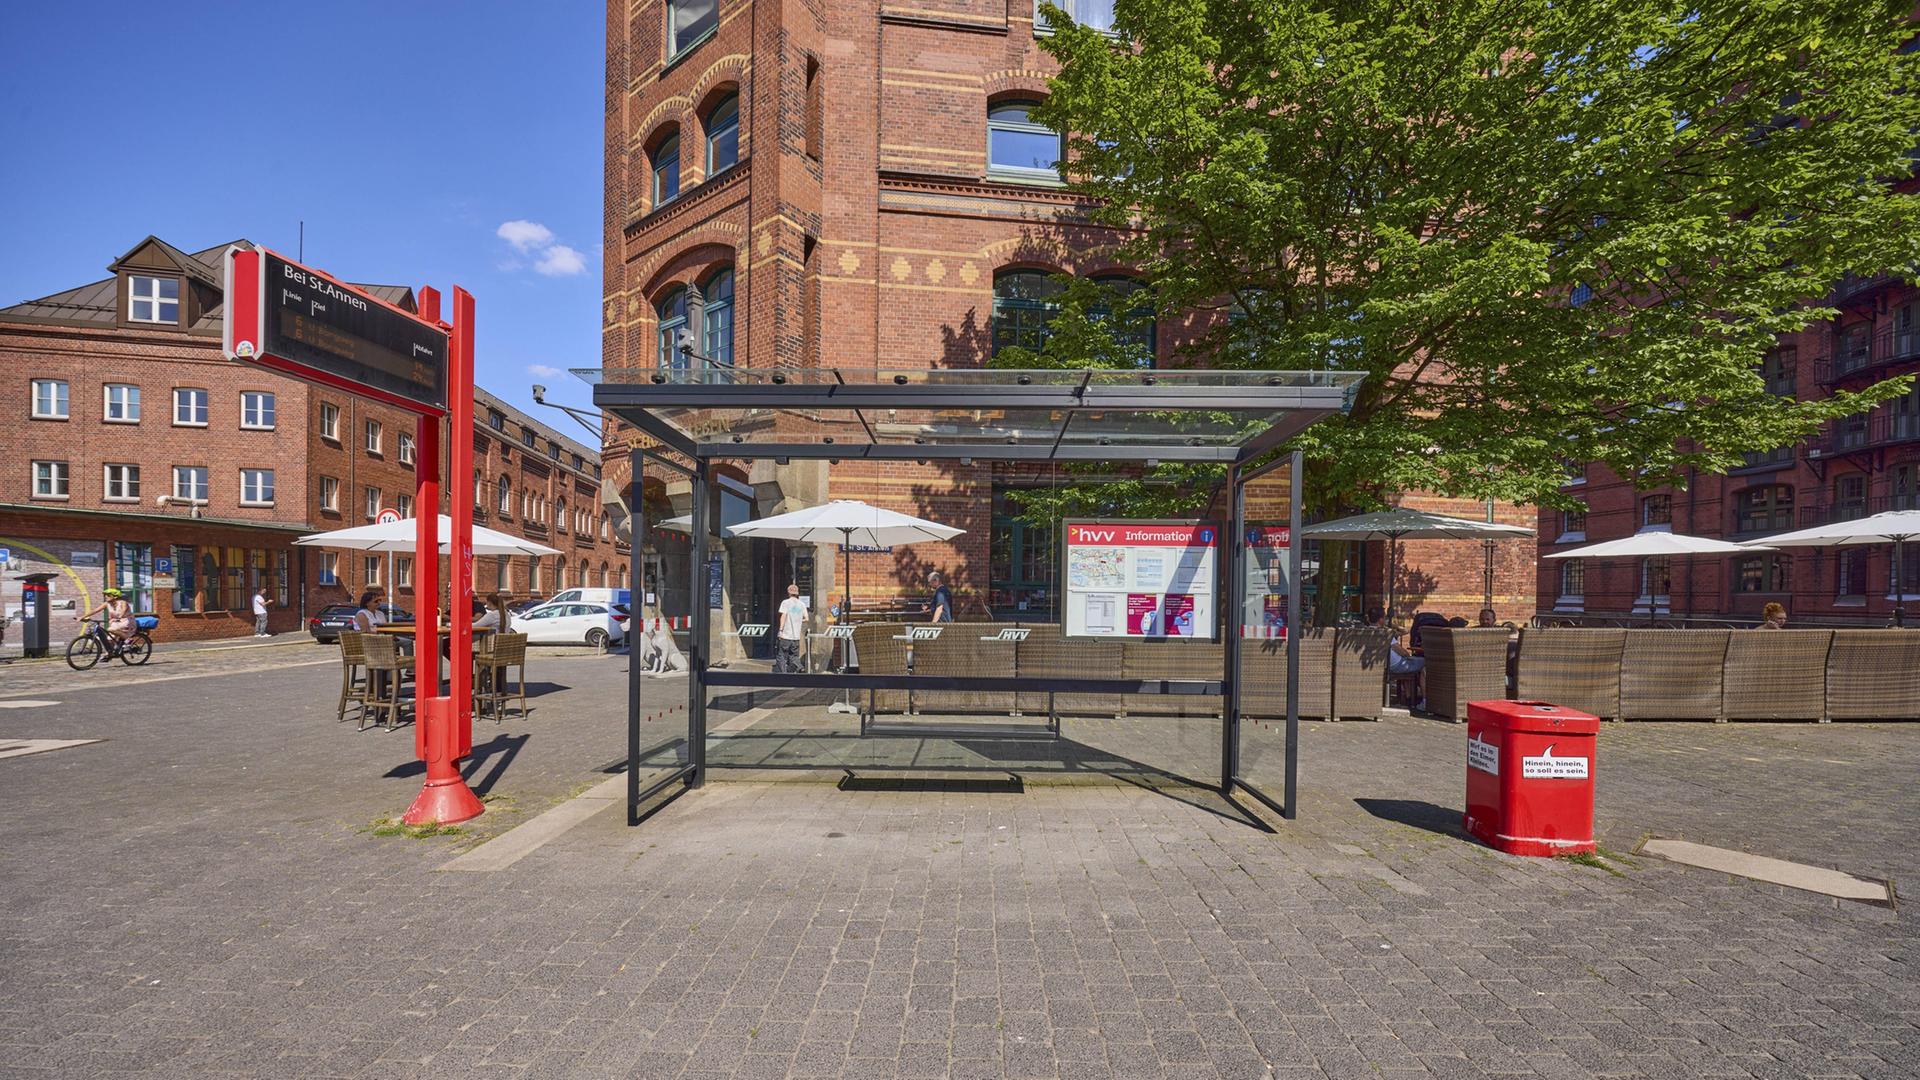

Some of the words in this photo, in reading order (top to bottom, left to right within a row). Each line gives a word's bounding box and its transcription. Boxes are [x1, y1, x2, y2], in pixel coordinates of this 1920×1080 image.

[284, 264, 306, 284] Bei
[285, 290, 302, 303] Linie
[313, 302, 326, 312] Ziel
[415, 344, 433, 356] Abfahrt
[1079, 527, 1115, 542] hvv
[1125, 530, 1193, 542] Information
[160, 560, 169, 571] P
[742, 626, 768, 636] HVV
[830, 628, 855, 637] HVV
[914, 630, 942, 639] HVV
[1002, 631, 1029, 640] HVV
[1470, 741, 1480, 751] Wirf
[1480, 752, 1496, 764] Eimer,
